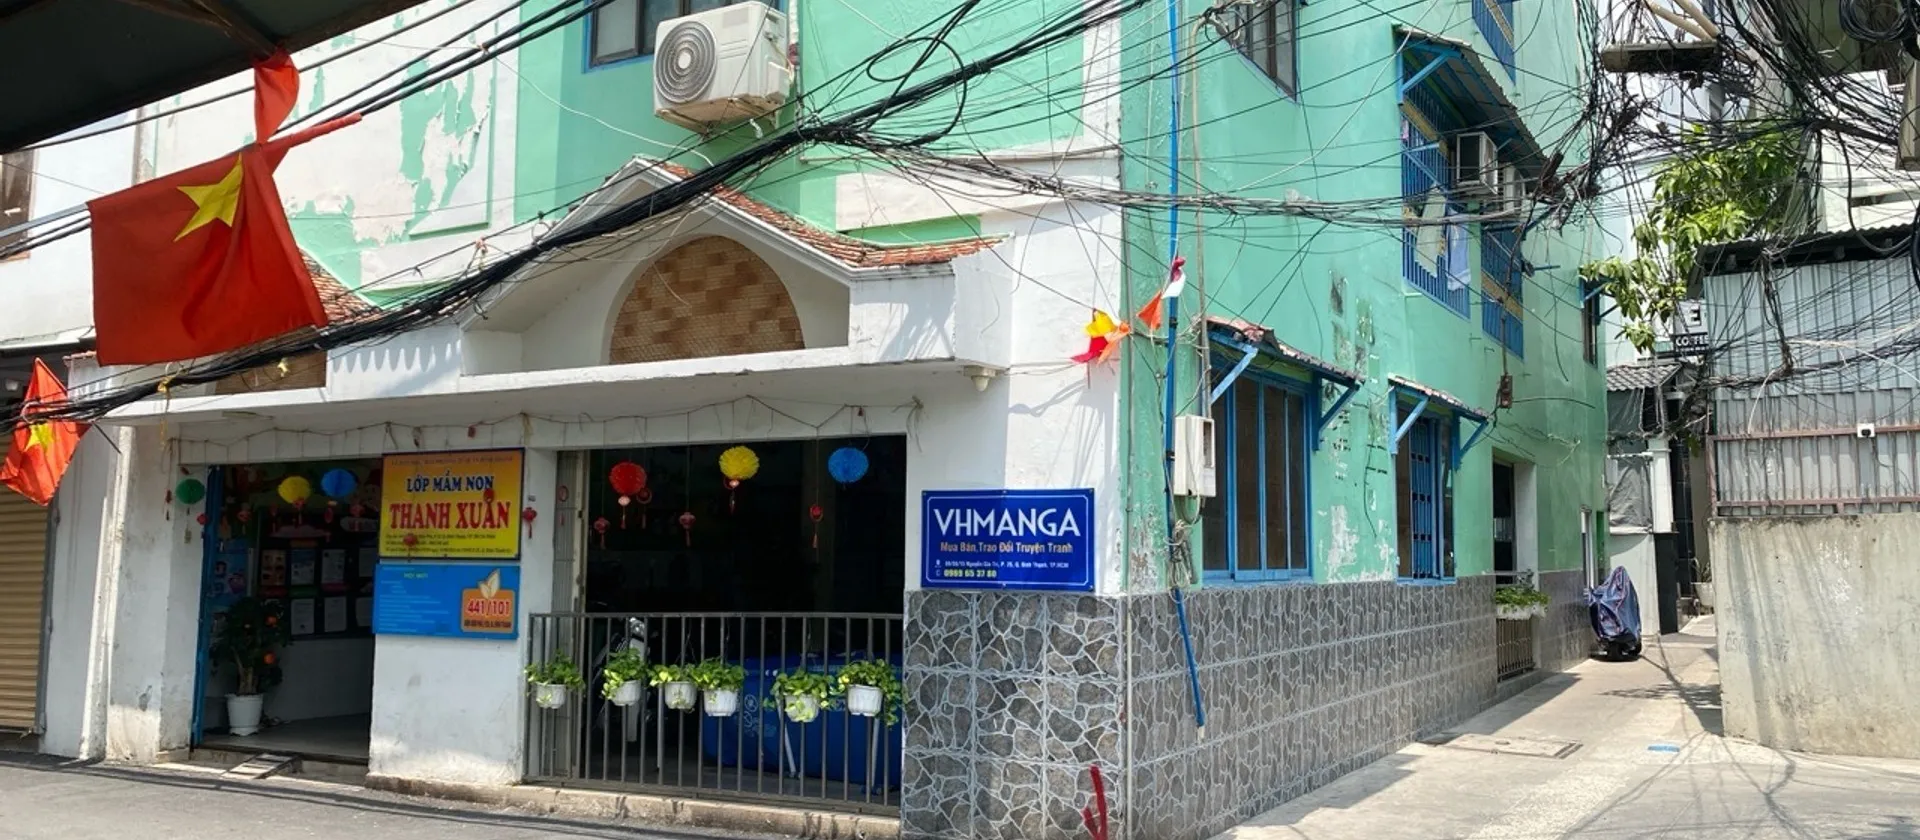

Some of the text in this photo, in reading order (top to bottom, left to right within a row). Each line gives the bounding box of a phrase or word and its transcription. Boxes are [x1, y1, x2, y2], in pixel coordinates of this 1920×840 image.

[1676, 335, 1709, 346] COFEE
[407, 474, 430, 492] LỚP
[466, 475, 495, 491] NON
[390, 501, 451, 529] THANH
[933, 508, 1081, 537] VHMANGA
[940, 542, 958, 552] Mua
[1016, 542, 1045, 554] Truyện
[1047, 543, 1073, 553] Tranh
[467, 600, 510, 616] 441/101
